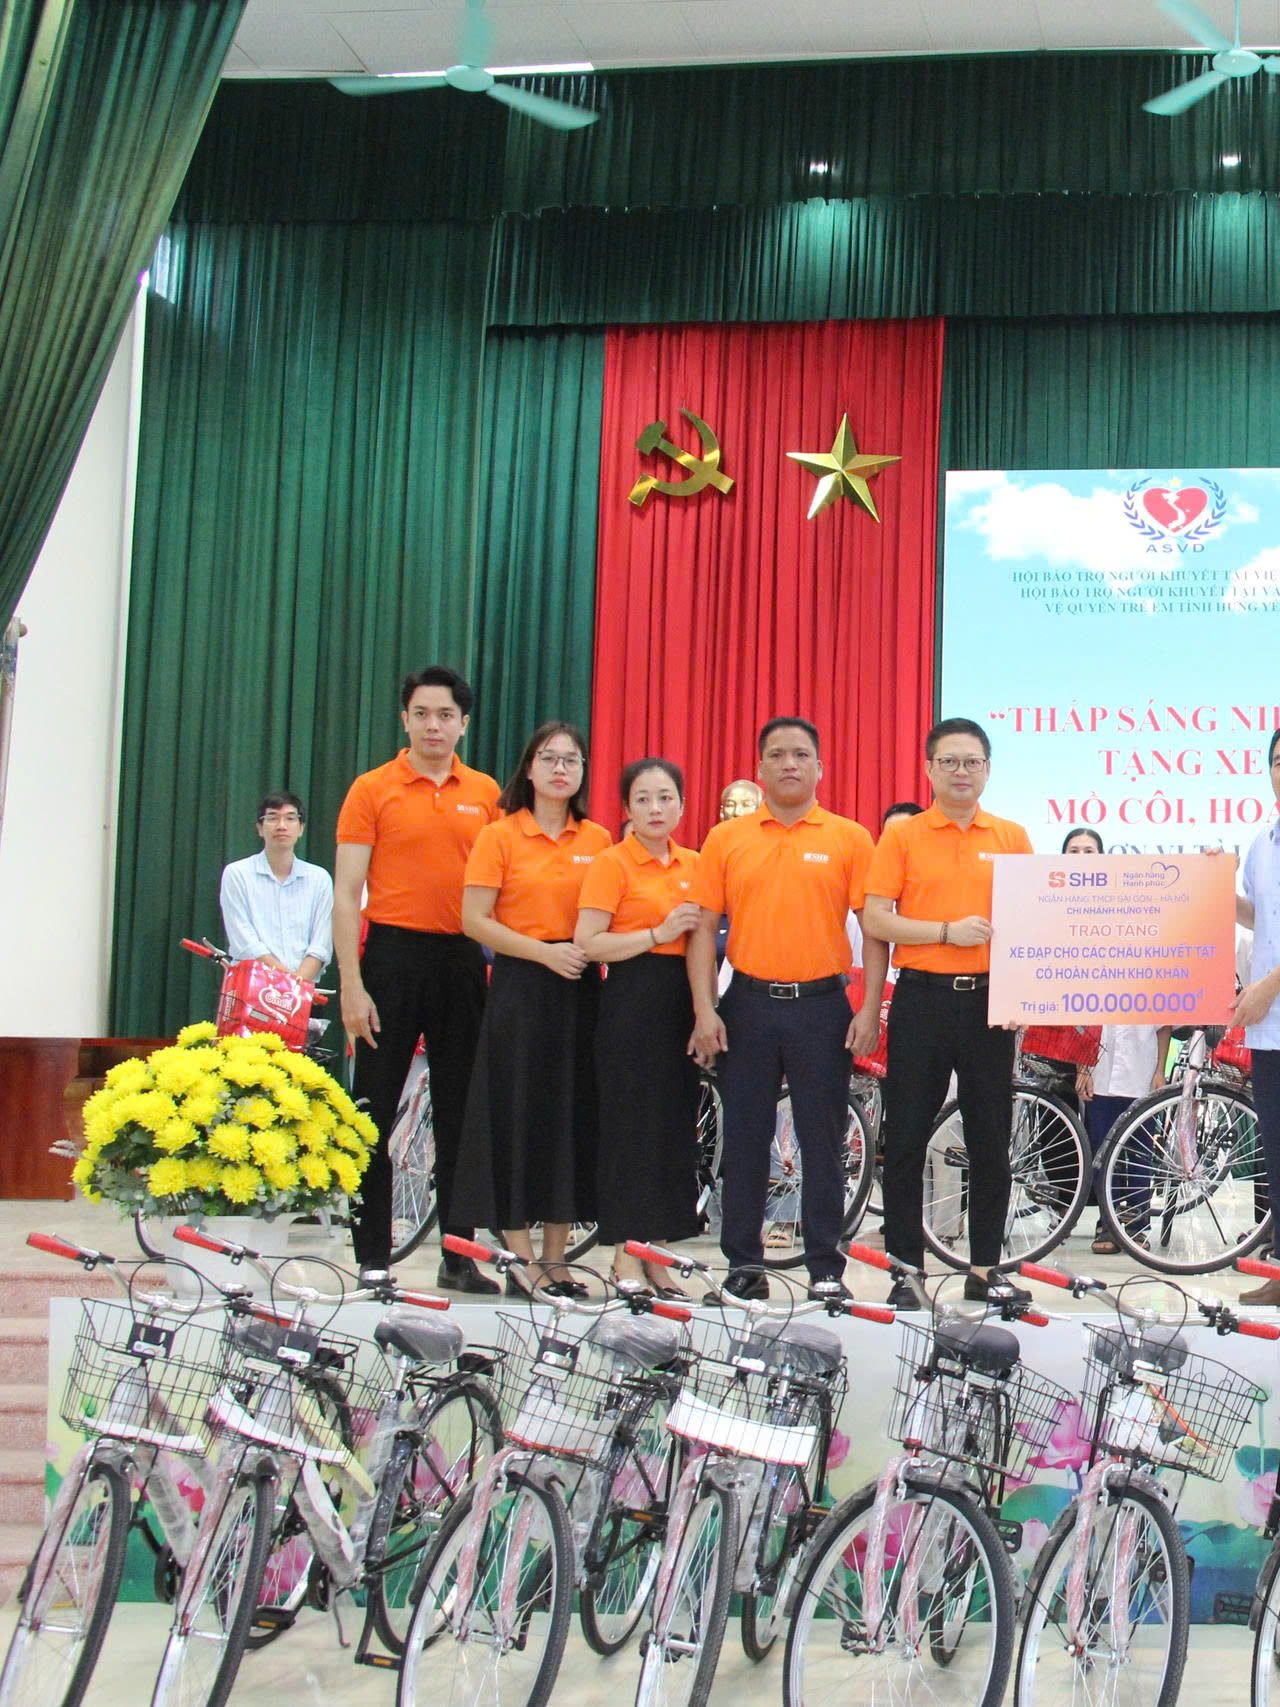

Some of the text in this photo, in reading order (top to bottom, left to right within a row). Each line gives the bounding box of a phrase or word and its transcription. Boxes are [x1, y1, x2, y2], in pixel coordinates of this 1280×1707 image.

[1146, 543, 1206, 553] ASVD
[1117, 698, 1217, 733] SÁNG
[1216, 749, 1264, 775] XE
[1046, 790, 1107, 824] MỒ
[1118, 789, 1197, 829] CÔI,
[1069, 872, 1108, 887] SHB
[1123, 871, 1165, 881] Ngân hàng
[1145, 879, 1165, 888] phúc
[1038, 893, 1063, 904] NGÂN
[1092, 895, 1115, 903] TMCP
[1143, 905, 1161, 914] YÊN
[1070, 925, 1112, 936] TRAO
[1009, 947, 1024, 958] XE
[1027, 947, 1050, 960] ĐẠP
[1053, 947, 1079, 958] CHO
[1082, 945, 1106, 958] CÁC
[1109, 944, 1142, 958] CHÁU
[1145, 943, 1192, 958] KHUYẾT
[1036, 965, 1052, 979] CÓ
[1055, 965, 1089, 979] HOÀN
[1128, 965, 1153, 979] KHÓ
[1020, 1002, 1036, 1012] Trị
